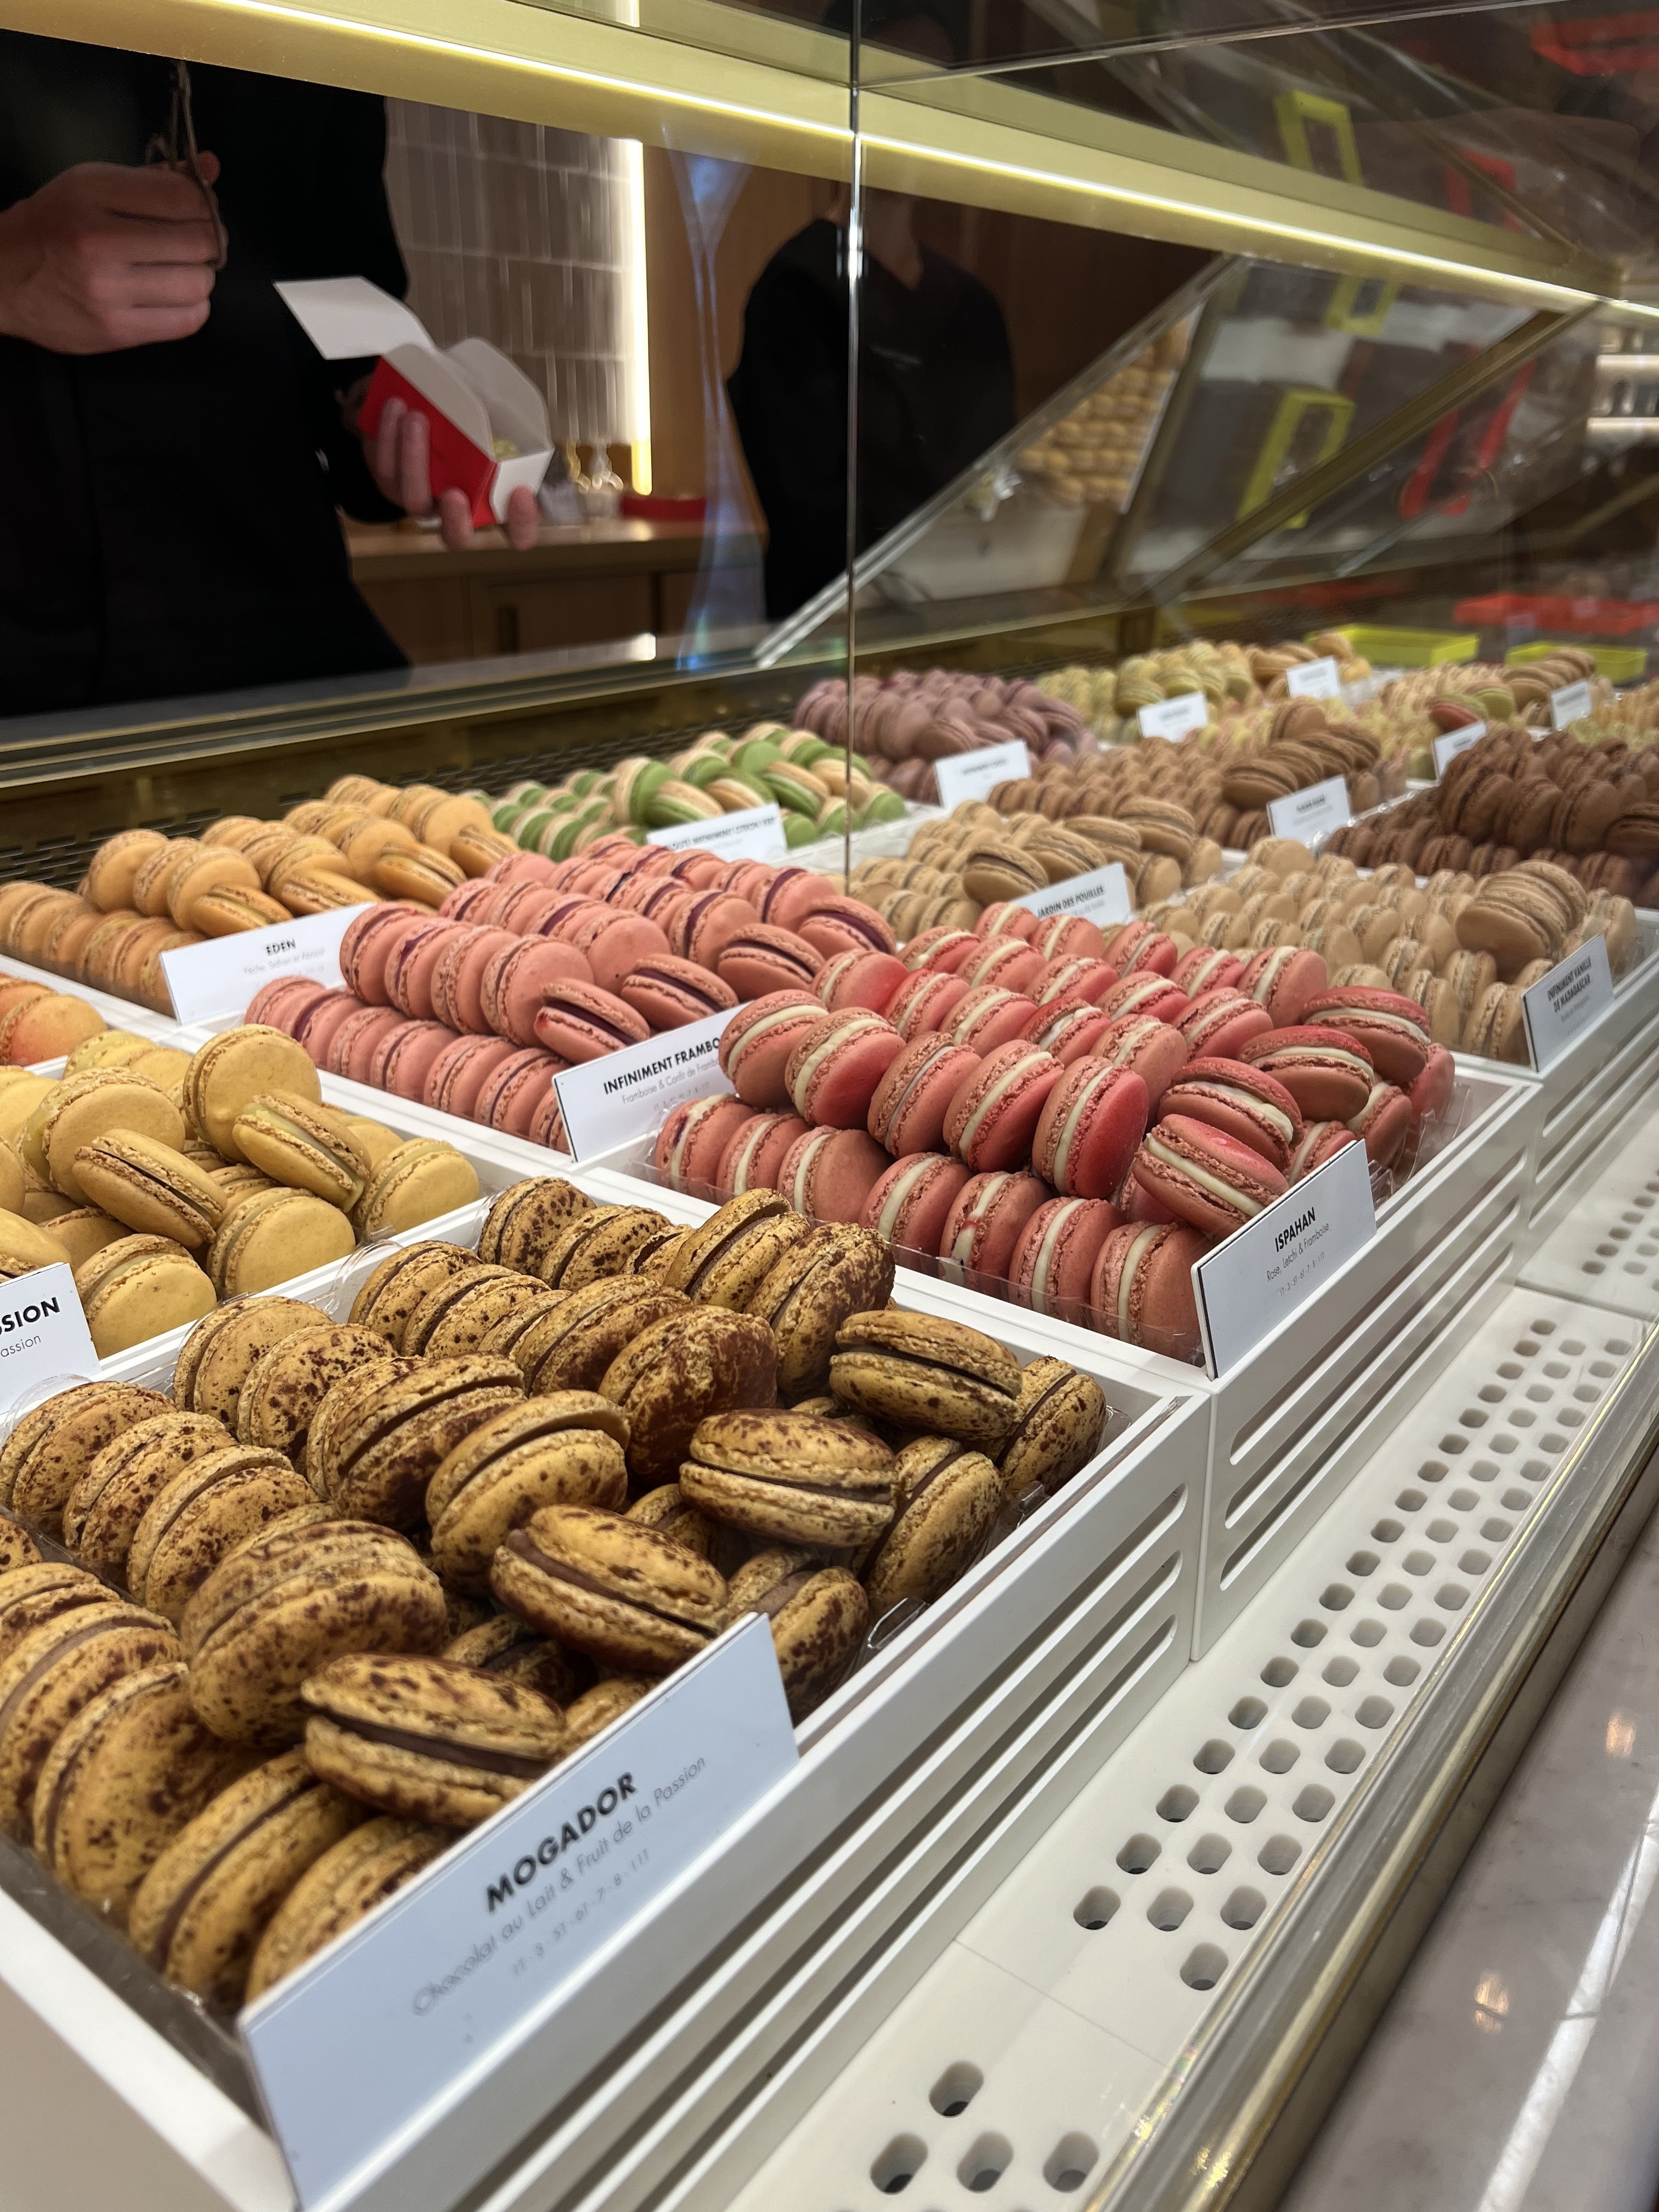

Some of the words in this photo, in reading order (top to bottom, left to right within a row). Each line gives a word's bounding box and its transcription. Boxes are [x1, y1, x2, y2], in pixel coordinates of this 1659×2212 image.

[266, 938, 296, 956] EDEN
[603, 1056, 673, 1094] INFINIMENT
[622, 1086, 658, 1104] Framboise
[659, 1079, 665, 1090] &
[687, 1067, 696, 1077] de
[1275, 1207, 1316, 1252] ISPAHAN
[1266, 1266, 1282, 1282] Rose,
[1282, 1248, 1298, 1268] Letchi
[1299, 1243, 1304, 1255] &
[1304, 1223, 1329, 1250] Framboise
[0, 1297, 60, 1335] SION
[486, 1771, 637, 1913] MOGADOR
[413, 1934, 497, 2016] Chocolat
[501, 1915, 524, 1939] au
[526, 1883, 556, 1918] Lait
[561, 1867, 575, 1889] &
[576, 1837, 609, 1874] Fruit
[613, 1820, 633, 1843] de
[635, 1805, 651, 1822] la
[653, 1757, 707, 1807] Passion
